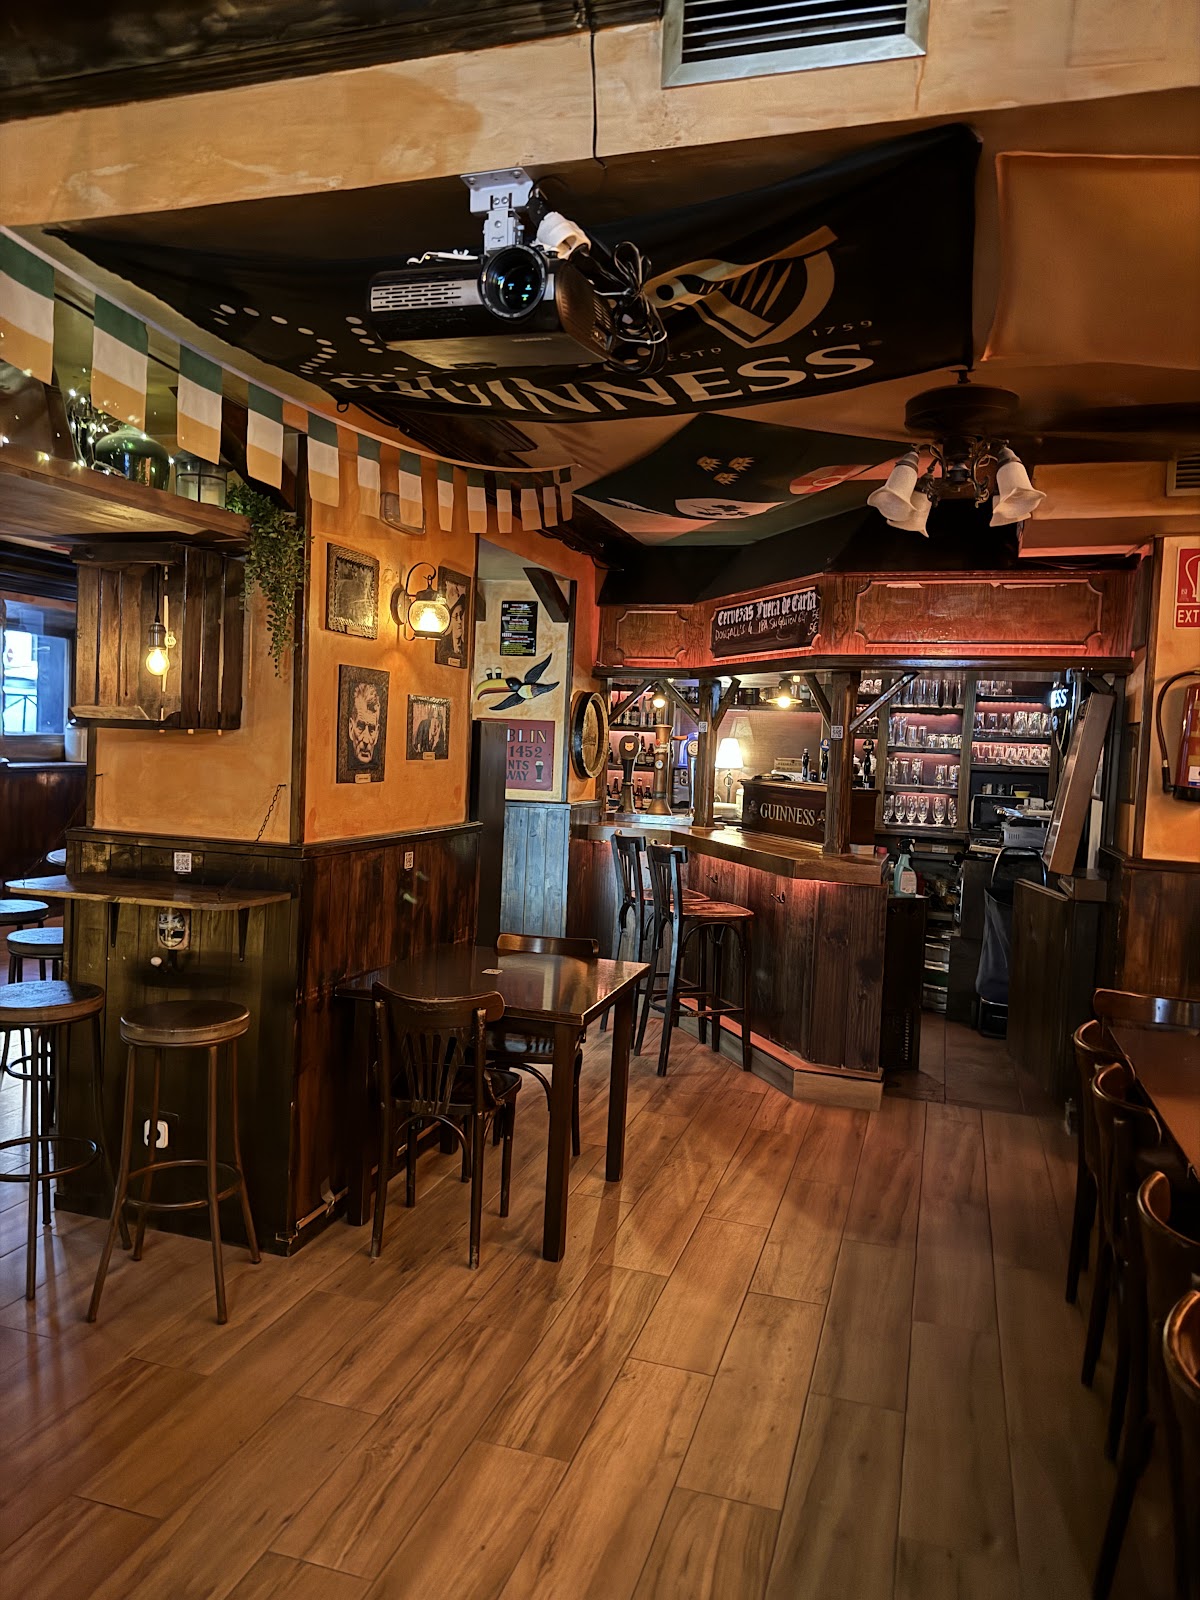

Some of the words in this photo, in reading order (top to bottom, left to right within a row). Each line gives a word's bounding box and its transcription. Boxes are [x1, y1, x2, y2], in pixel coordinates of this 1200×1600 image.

[812, 320, 873, 337] 1759
[718, 604, 754, 626] Cervezas
[782, 597, 791, 615] de
[792, 591, 816, 612] Carta
[1177, 609, 1200, 623] EXT
[510, 746, 543, 758] 1452
[760, 803, 815, 827] GUINNESS
